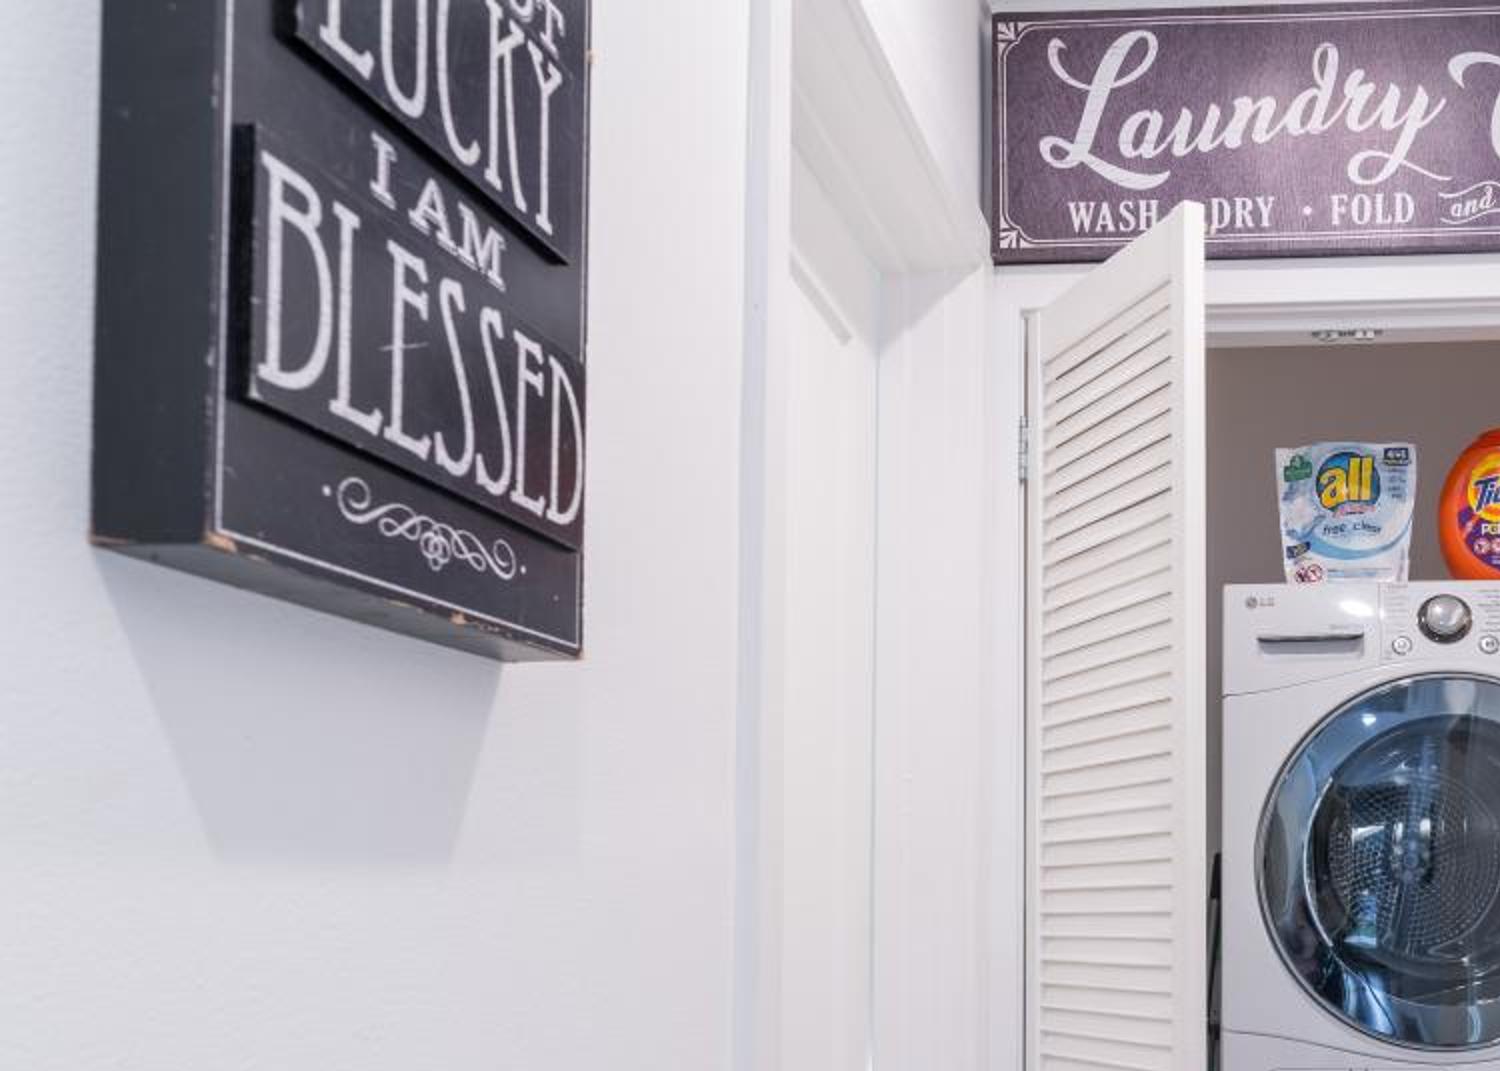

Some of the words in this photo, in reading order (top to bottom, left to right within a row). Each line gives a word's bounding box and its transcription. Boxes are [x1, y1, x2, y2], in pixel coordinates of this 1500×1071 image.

[1039, 30, 1453, 191] Laundry
[370, 132, 397, 210] I
[408, 178, 507, 292] AM
[1068, 199, 1159, 233] WASH
[1210, 196, 1275, 229] DRY
[1331, 192, 1415, 225] FOLD
[1450, 186, 1496, 218] and
[258, 150, 584, 525] BLESSED
[1319, 456, 1375, 510] all
